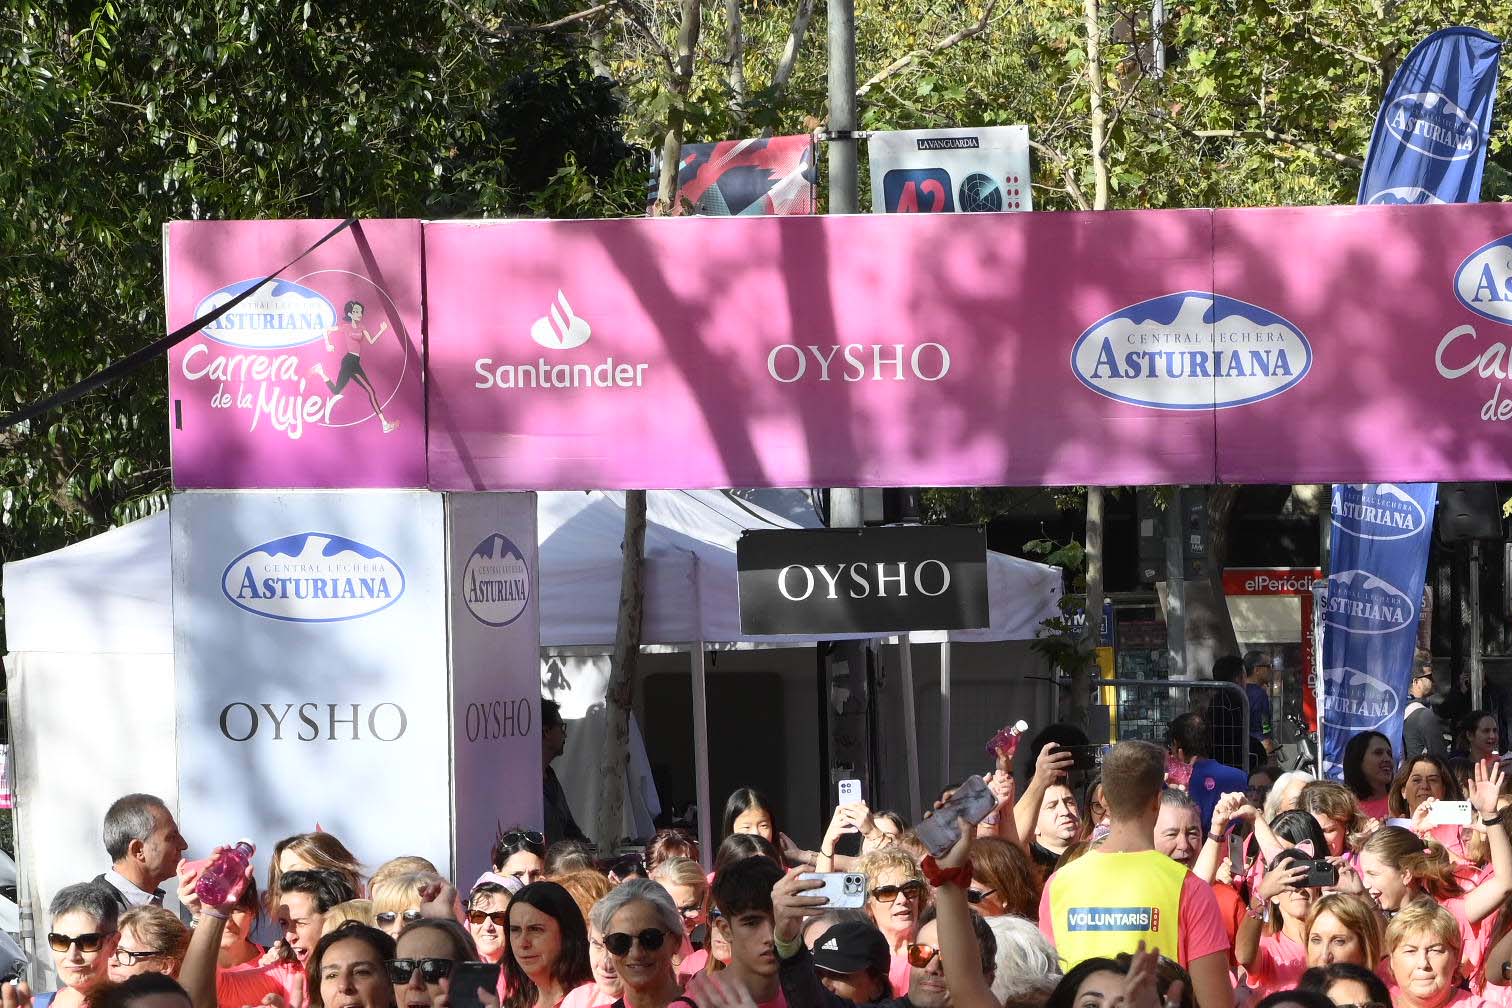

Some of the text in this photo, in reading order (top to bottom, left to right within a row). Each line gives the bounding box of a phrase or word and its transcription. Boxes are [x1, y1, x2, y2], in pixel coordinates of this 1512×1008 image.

[1127, 330, 1286, 345] CENTRAL LECHERA
[182, 343, 299, 381] Carrera
[475, 357, 648, 390] Santander
[767, 342, 951, 383] OYSHO
[1090, 336, 1294, 380] ASTURIANA
[211, 378, 344, 440] de la Mujer
[1331, 491, 1414, 531] ASTURIANA
[236, 565, 392, 600] ASTURIANA
[264, 563, 321, 574] CENTRAL
[468, 569, 527, 604] ASTURIANA
[777, 559, 951, 602] OYSHO
[219, 702, 408, 742] OYSHO
[465, 698, 532, 743] OYSHO
[1069, 913, 1149, 926] VOLUNTARIS
